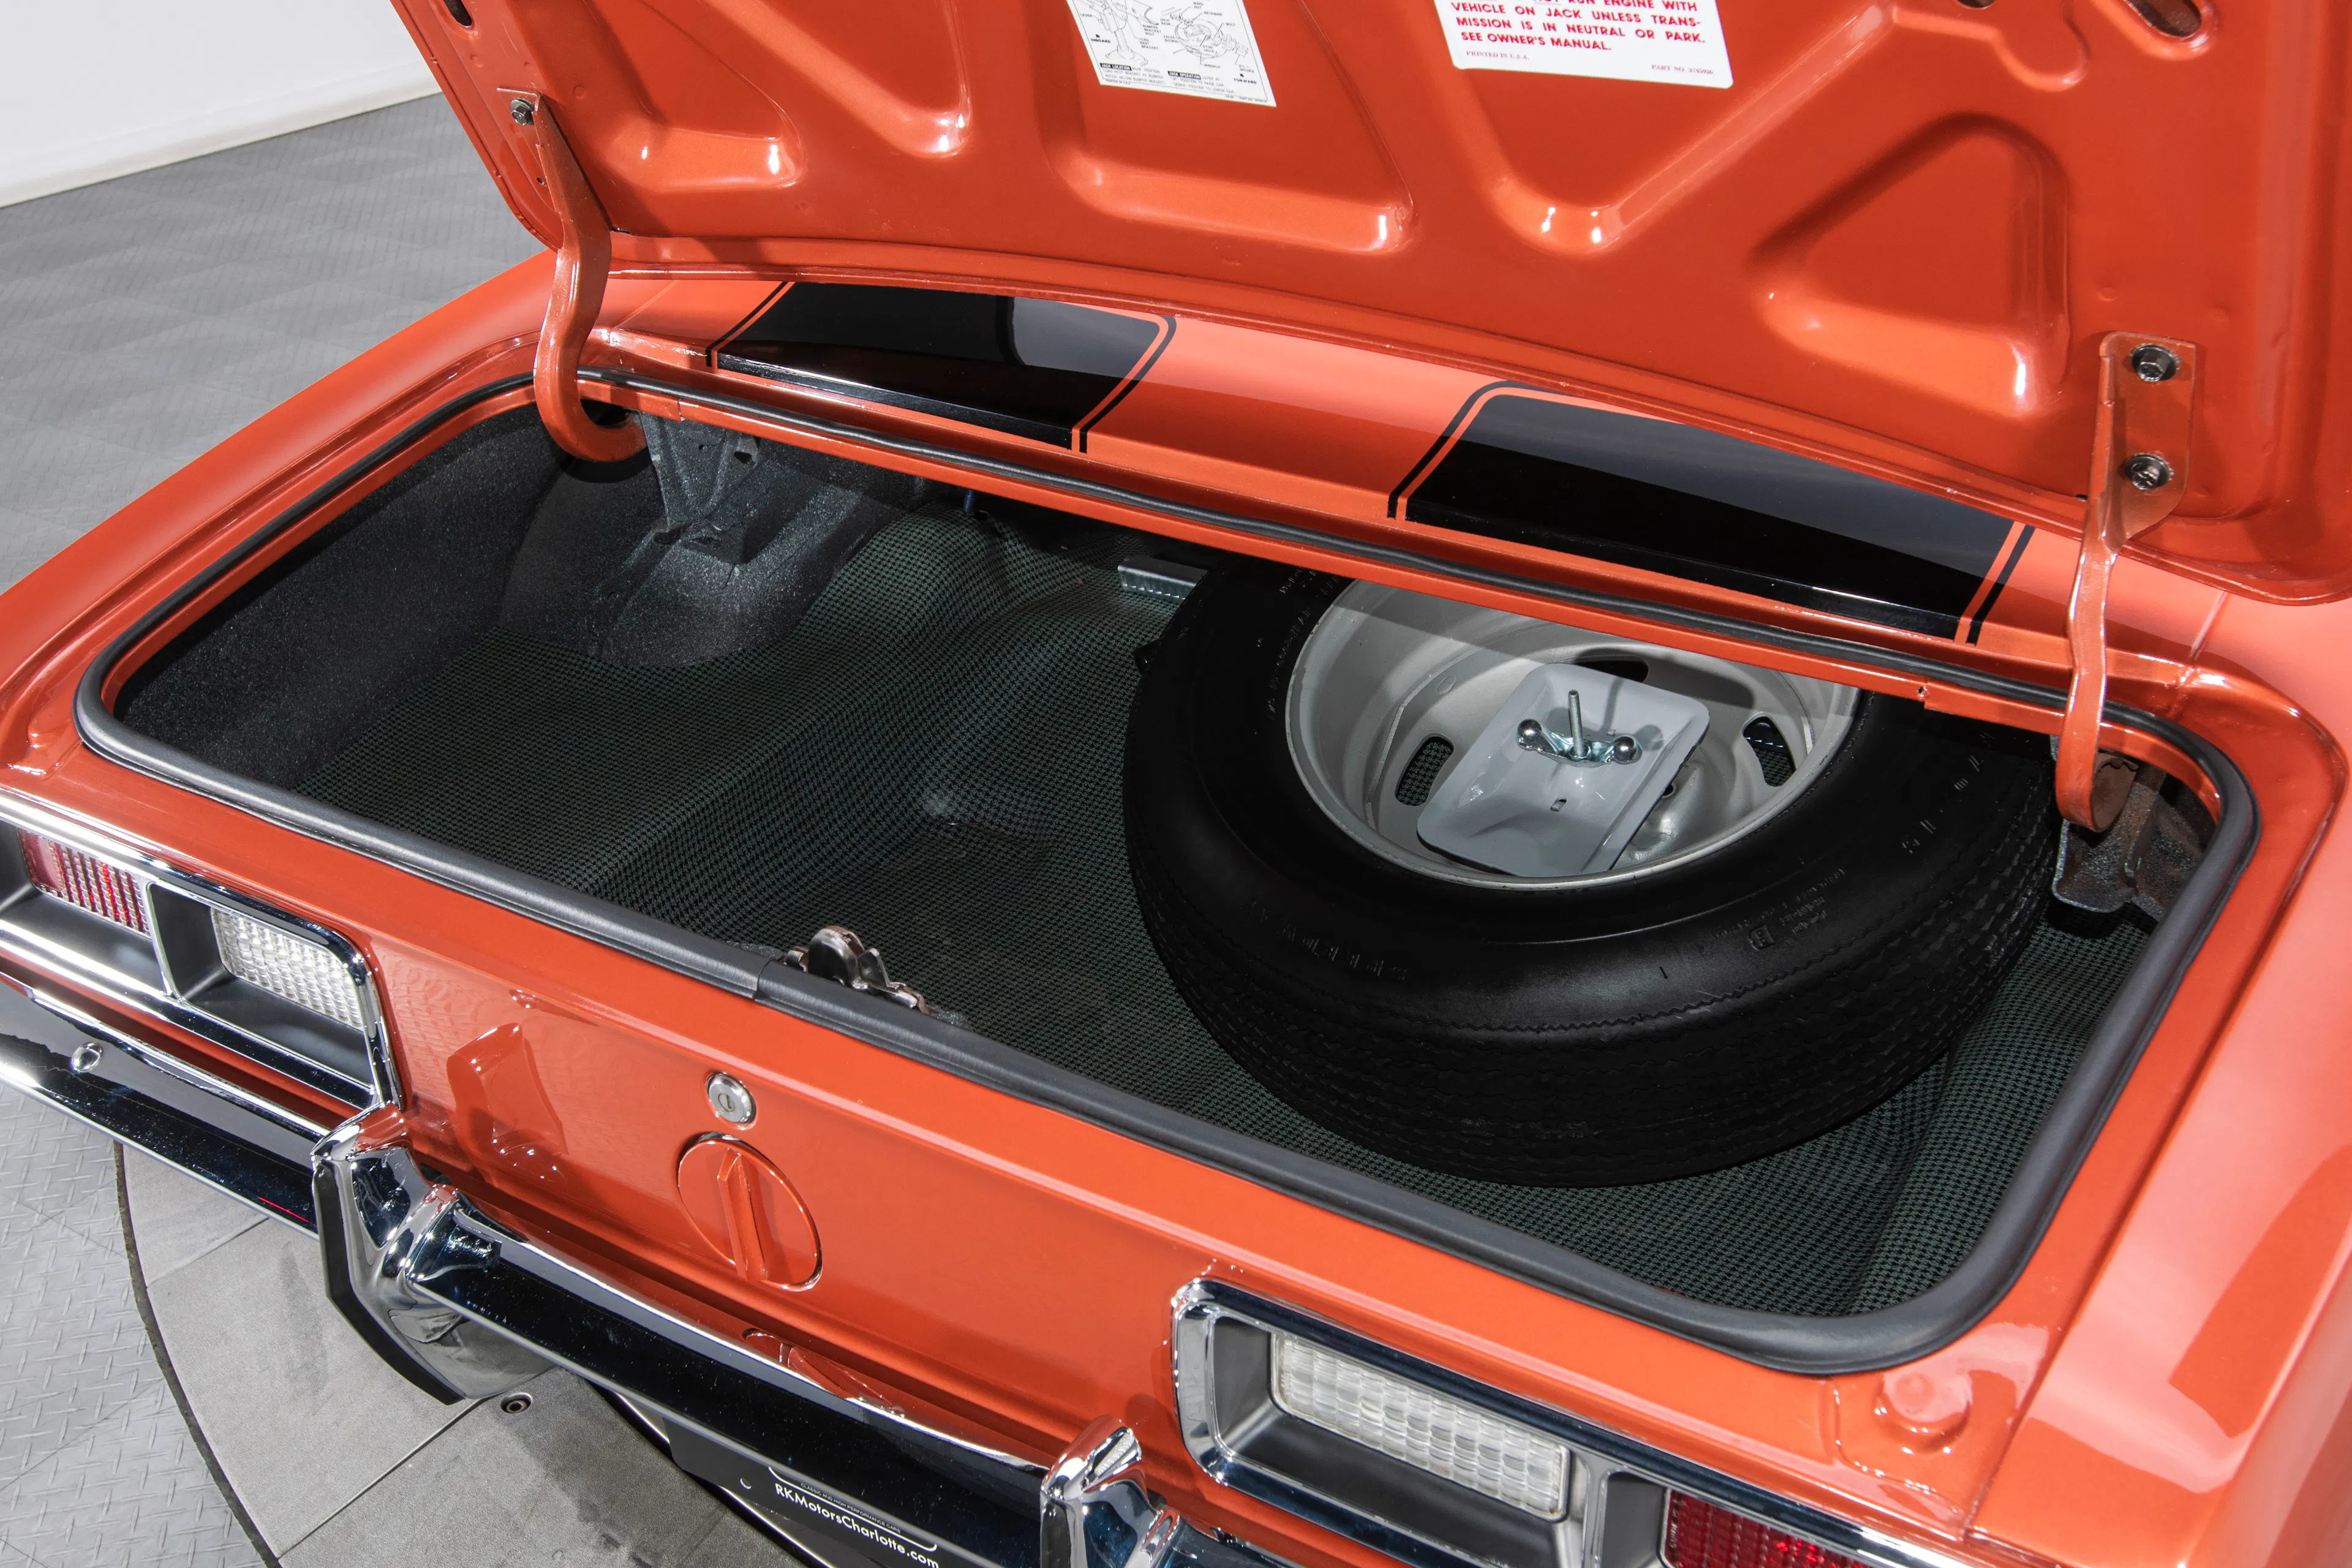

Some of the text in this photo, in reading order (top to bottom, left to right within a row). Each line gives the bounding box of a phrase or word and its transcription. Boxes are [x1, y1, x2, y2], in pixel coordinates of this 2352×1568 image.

[1451, 1, 1702, 27] VEHICLE ON JACK UNLESS TRANS-
[1662, 0, 1698, 11] WITH
[1456, 17, 1706, 43] MISSION IS IN NEUTRAL OR PARK.
[1461, 31, 1611, 51] SEE OWNER'S MANUAL.
[800, 1482, 902, 1534] CLASSIC AND HIGH PERFORMANCE CARS
[774, 1482, 940, 1568] RKMotorsCharlotte.com
